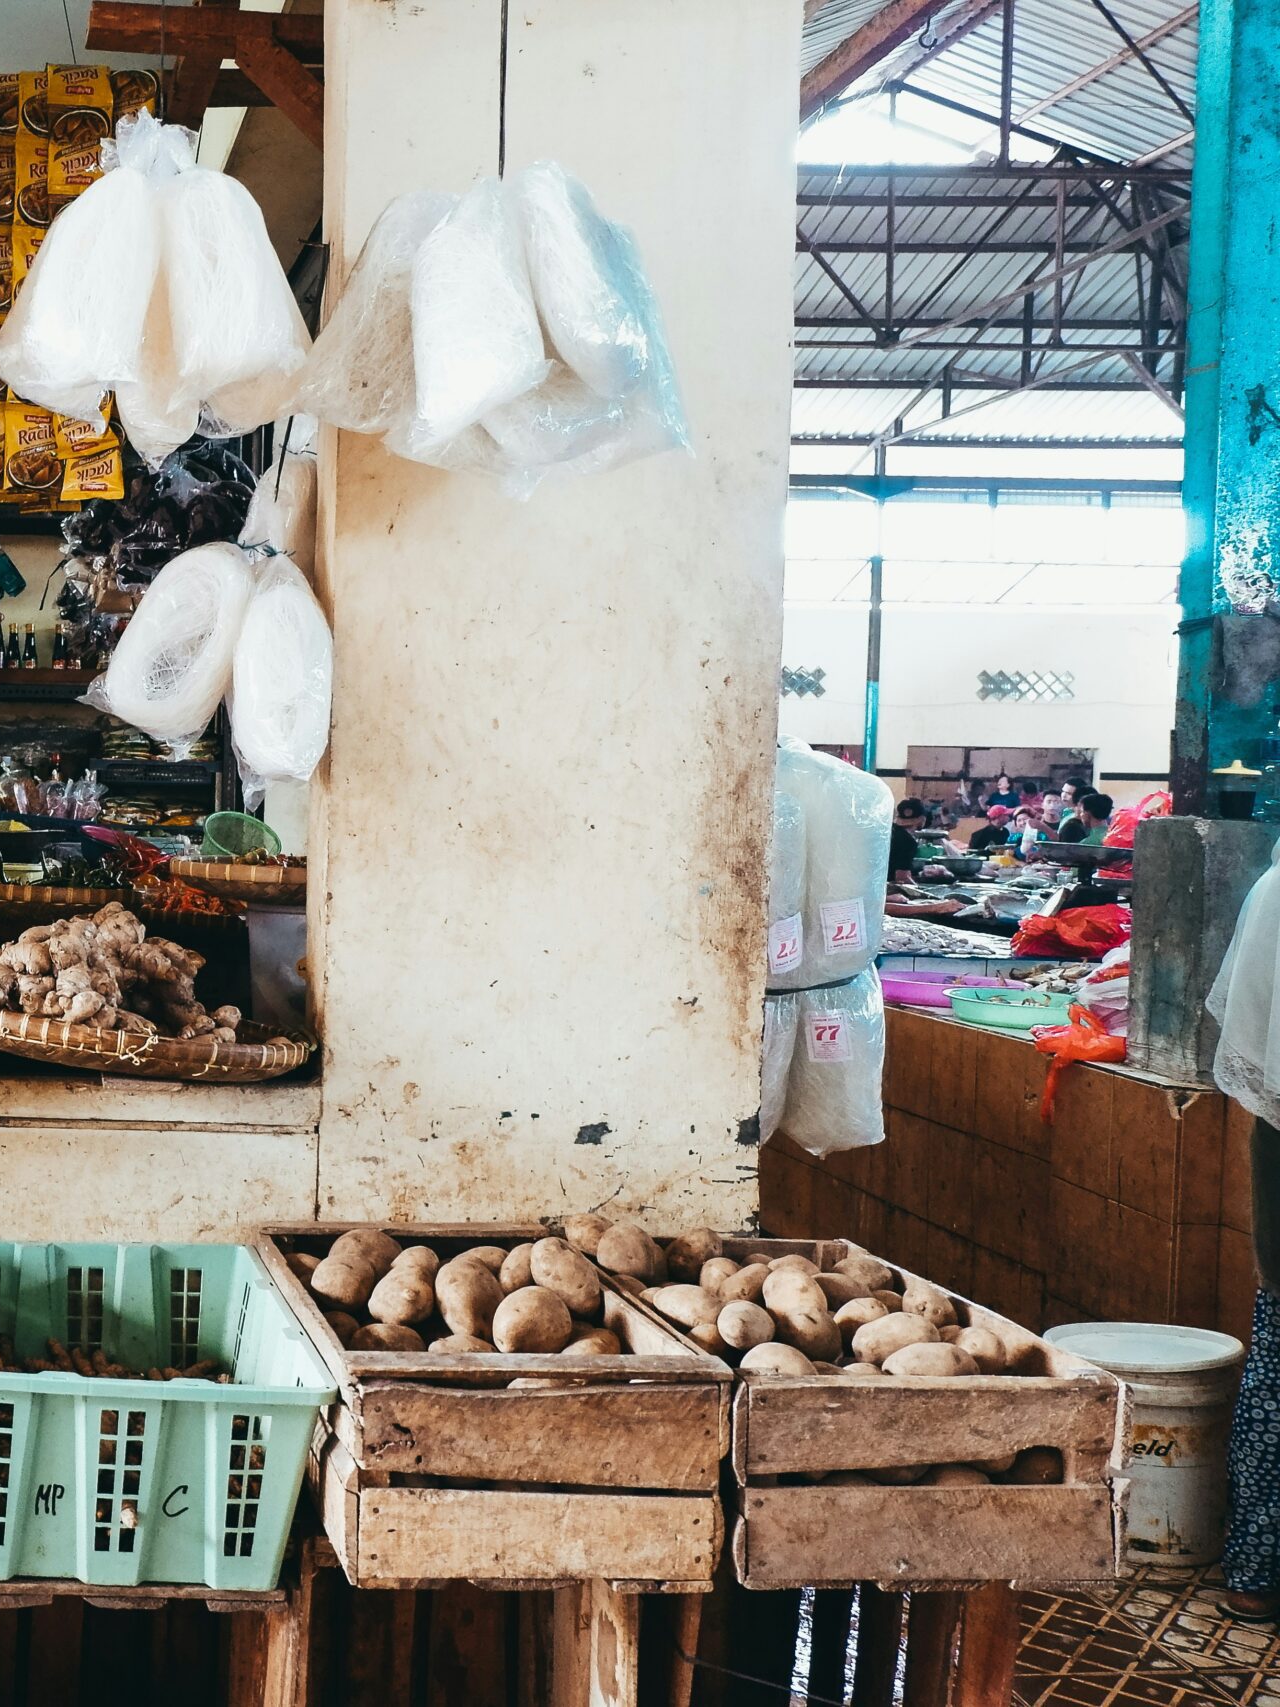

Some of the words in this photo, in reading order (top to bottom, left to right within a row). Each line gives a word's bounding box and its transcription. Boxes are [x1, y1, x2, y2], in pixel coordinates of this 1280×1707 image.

[62, 68, 100, 84] Racik
[18, 424, 56, 446] Racik
[76, 459, 114, 481] Racik
[831, 922, 858, 942] 77
[776, 937, 799, 960] 77
[814, 1024, 841, 1041] 77
[34, 1483, 66, 1516] MP
[161, 1484, 190, 1518] C
